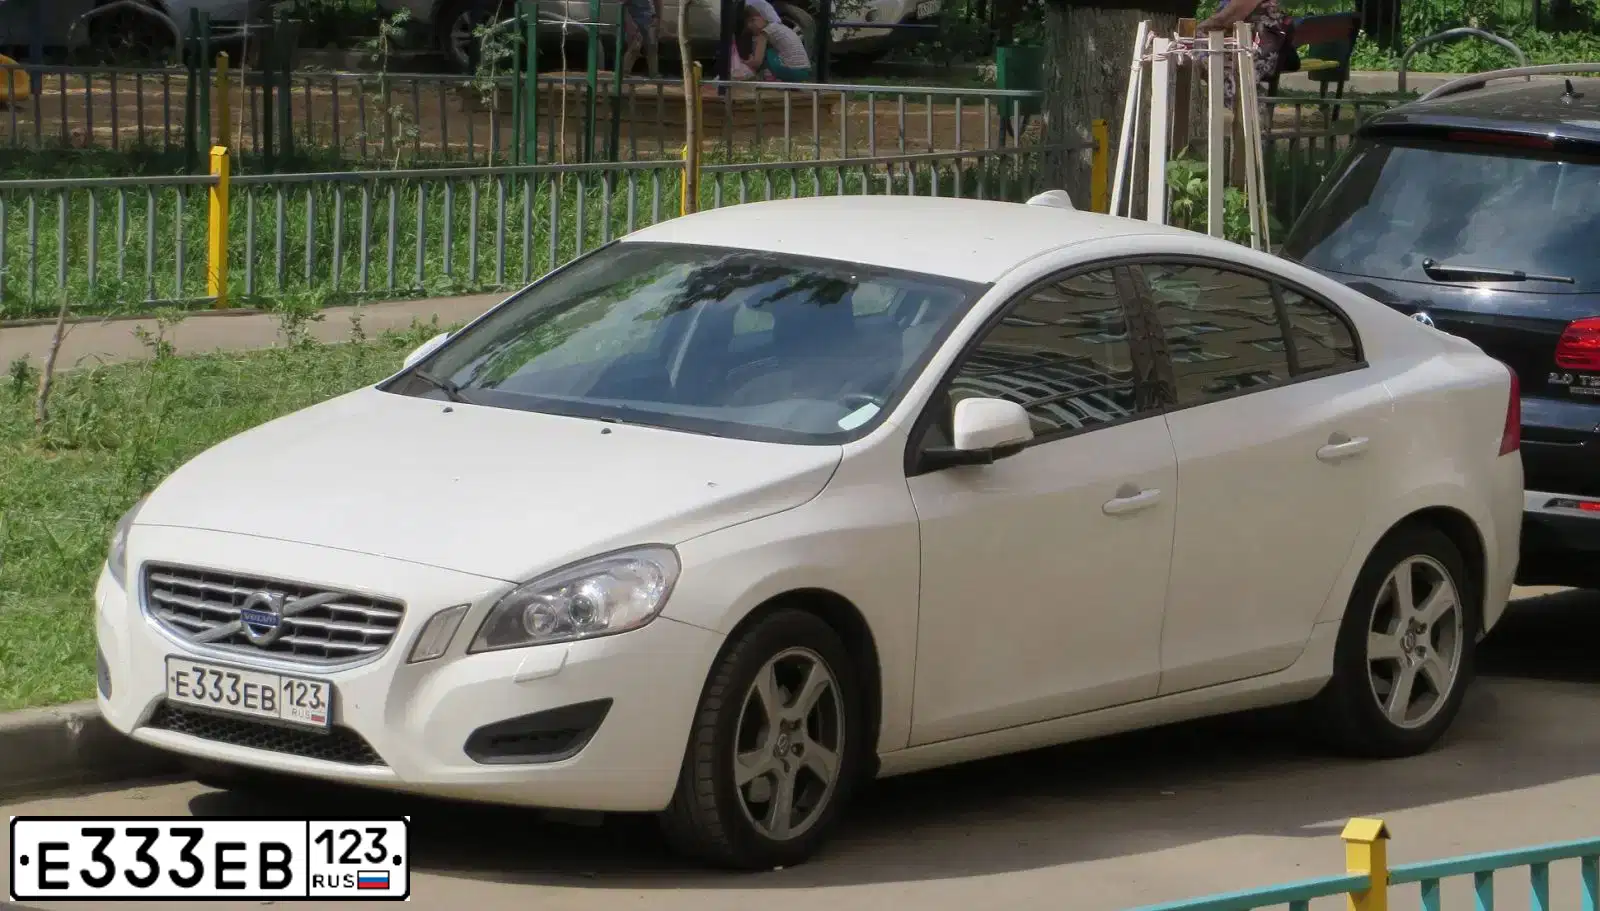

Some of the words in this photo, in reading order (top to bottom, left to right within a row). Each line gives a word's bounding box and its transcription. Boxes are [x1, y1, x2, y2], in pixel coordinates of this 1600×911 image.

[175, 666, 276, 711] E333EB
[283, 680, 322, 710] 123
[291, 707, 311, 720] RUS
